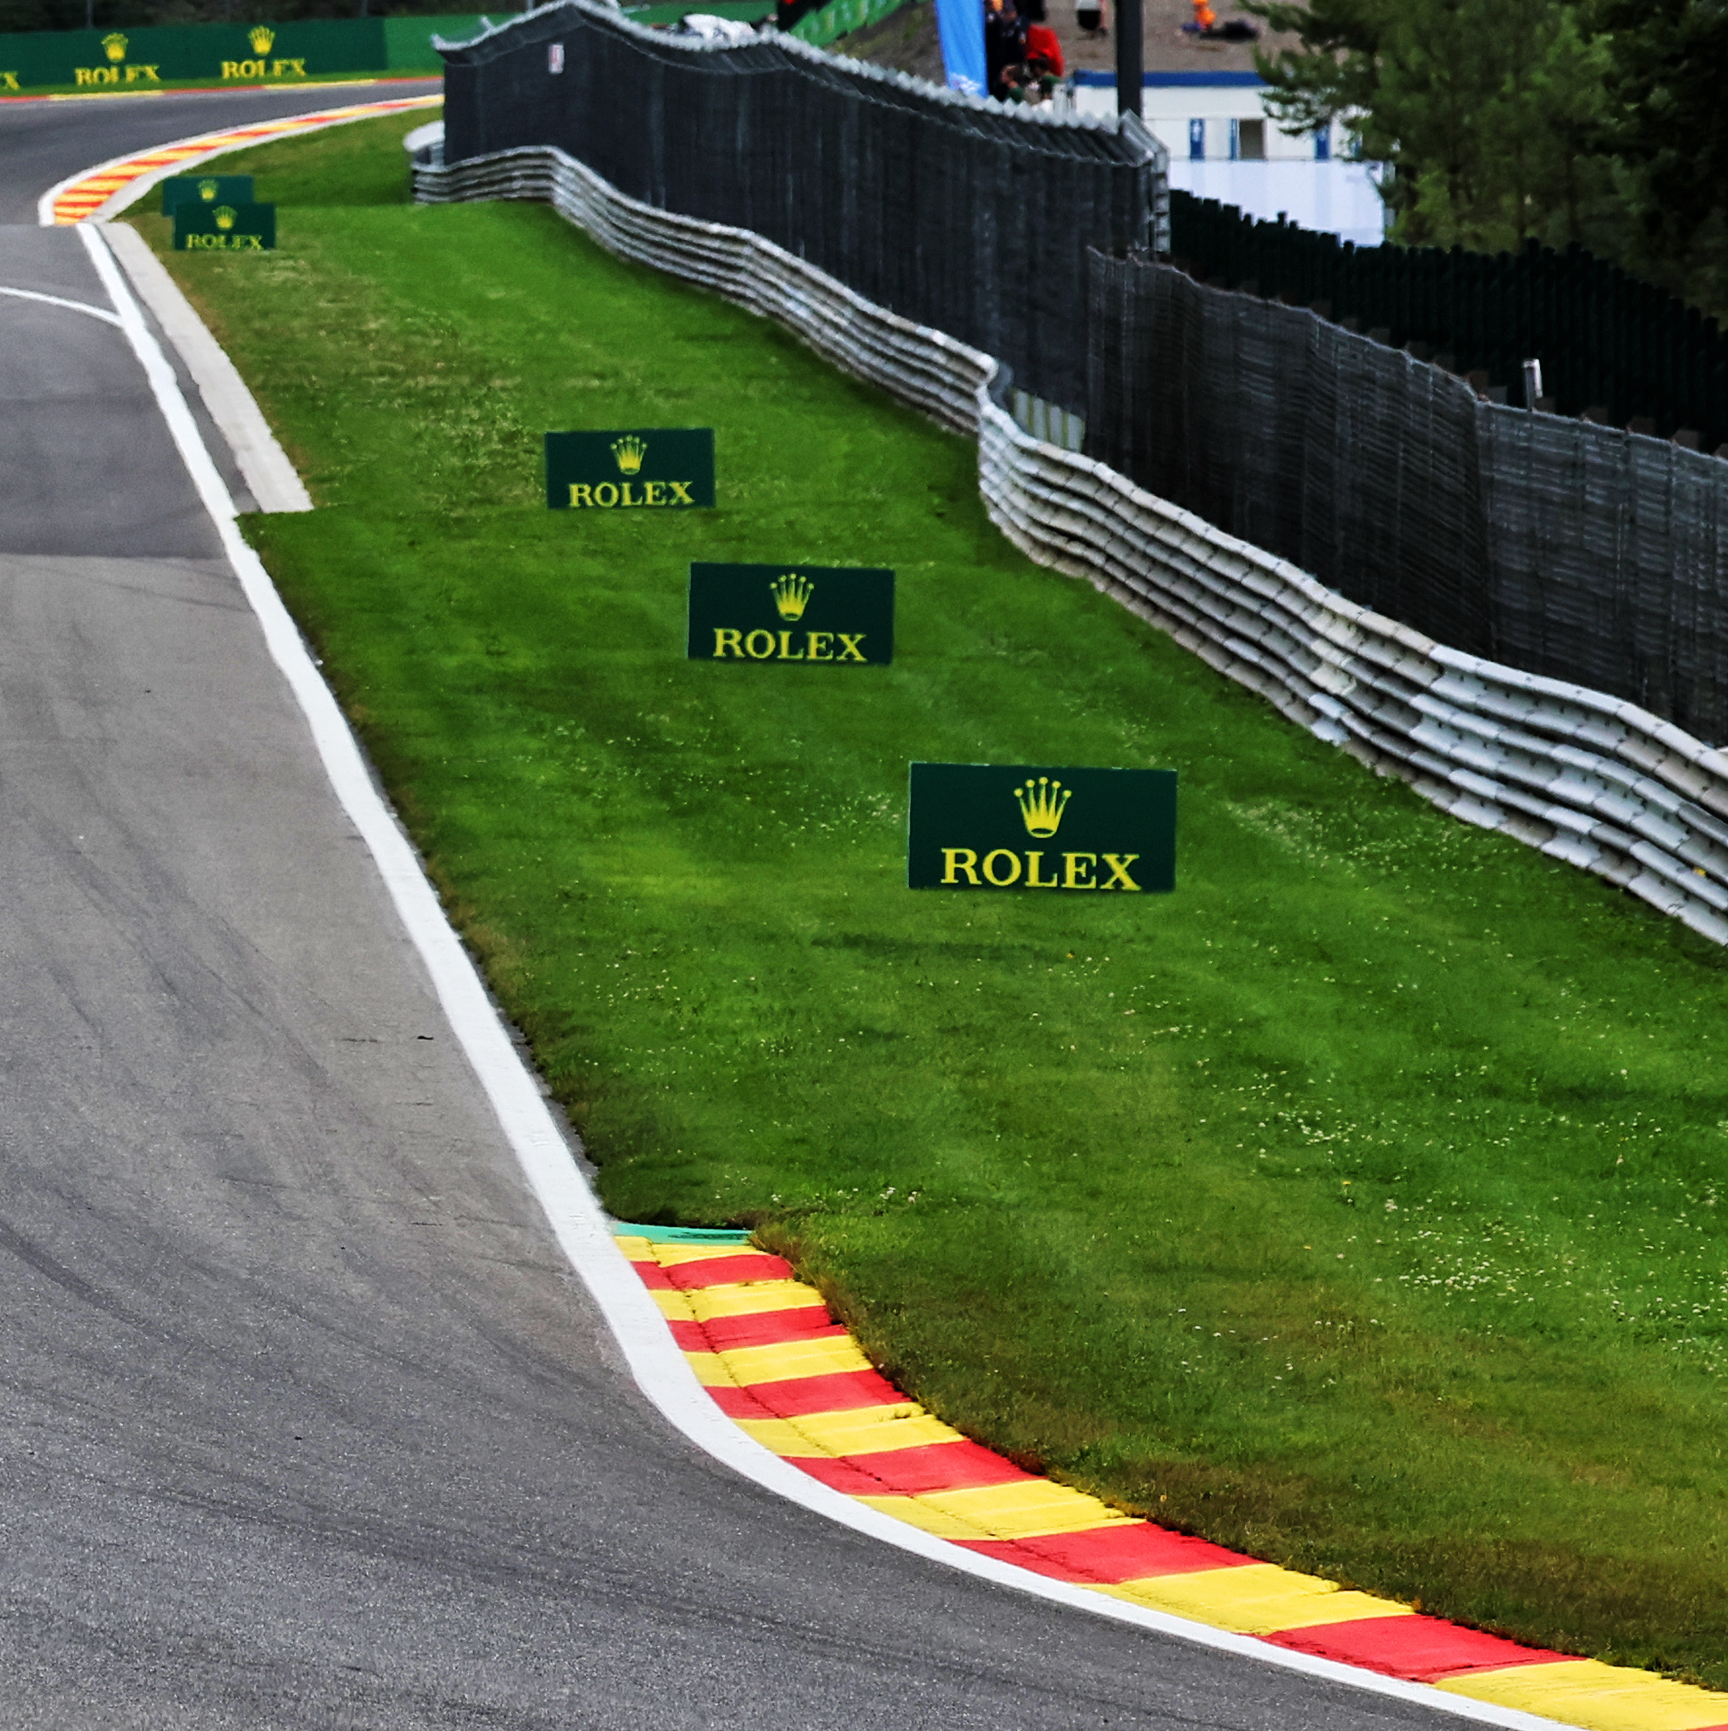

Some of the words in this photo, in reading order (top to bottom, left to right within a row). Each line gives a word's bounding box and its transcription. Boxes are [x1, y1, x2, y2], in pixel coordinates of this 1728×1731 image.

[76, 66, 159, 86] ROLEX
[223, 60, 306, 79] ROLEX
[568, 481, 694, 508] ROLEX
[713, 628, 867, 662] ROLEX
[940, 847, 1141, 892] ROLEX
